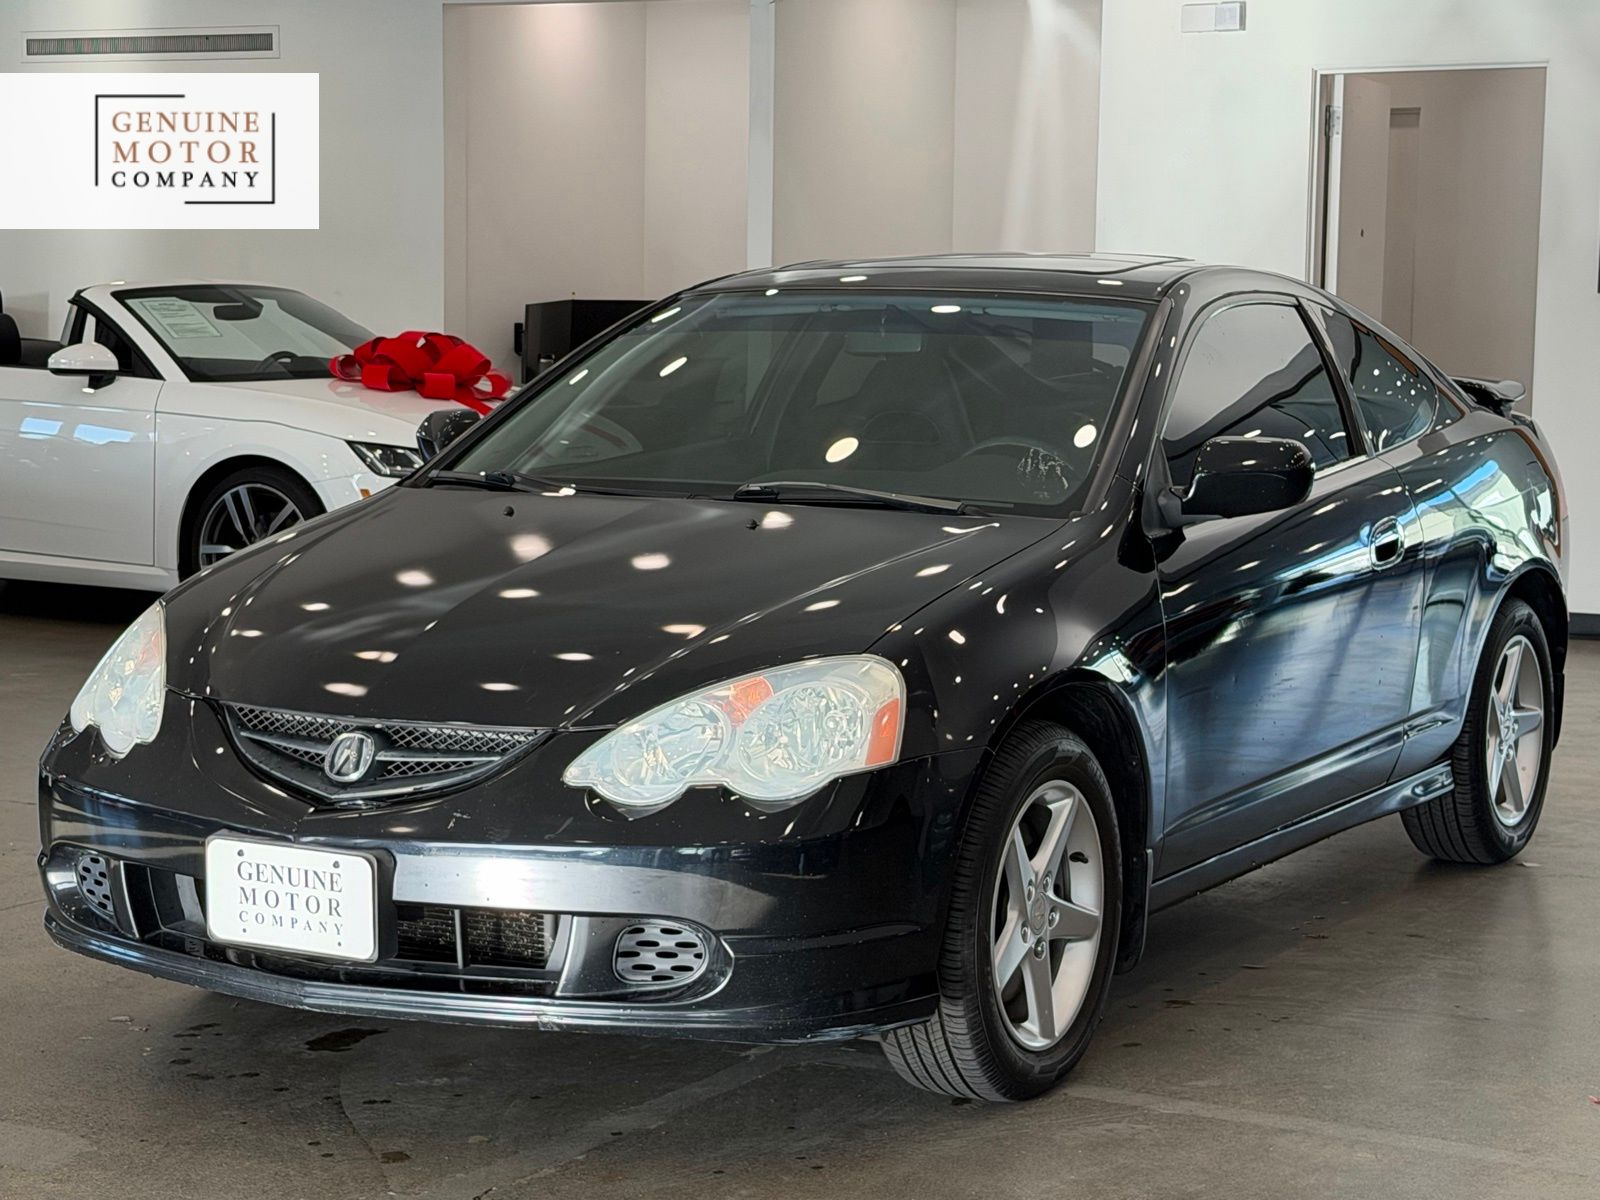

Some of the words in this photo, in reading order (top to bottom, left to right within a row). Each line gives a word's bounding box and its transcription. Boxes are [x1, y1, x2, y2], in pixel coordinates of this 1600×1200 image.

[237, 861, 342, 893] GENUINE
[239, 886, 342, 917] MOTOR
[239, 910, 343, 936] COMPANY
